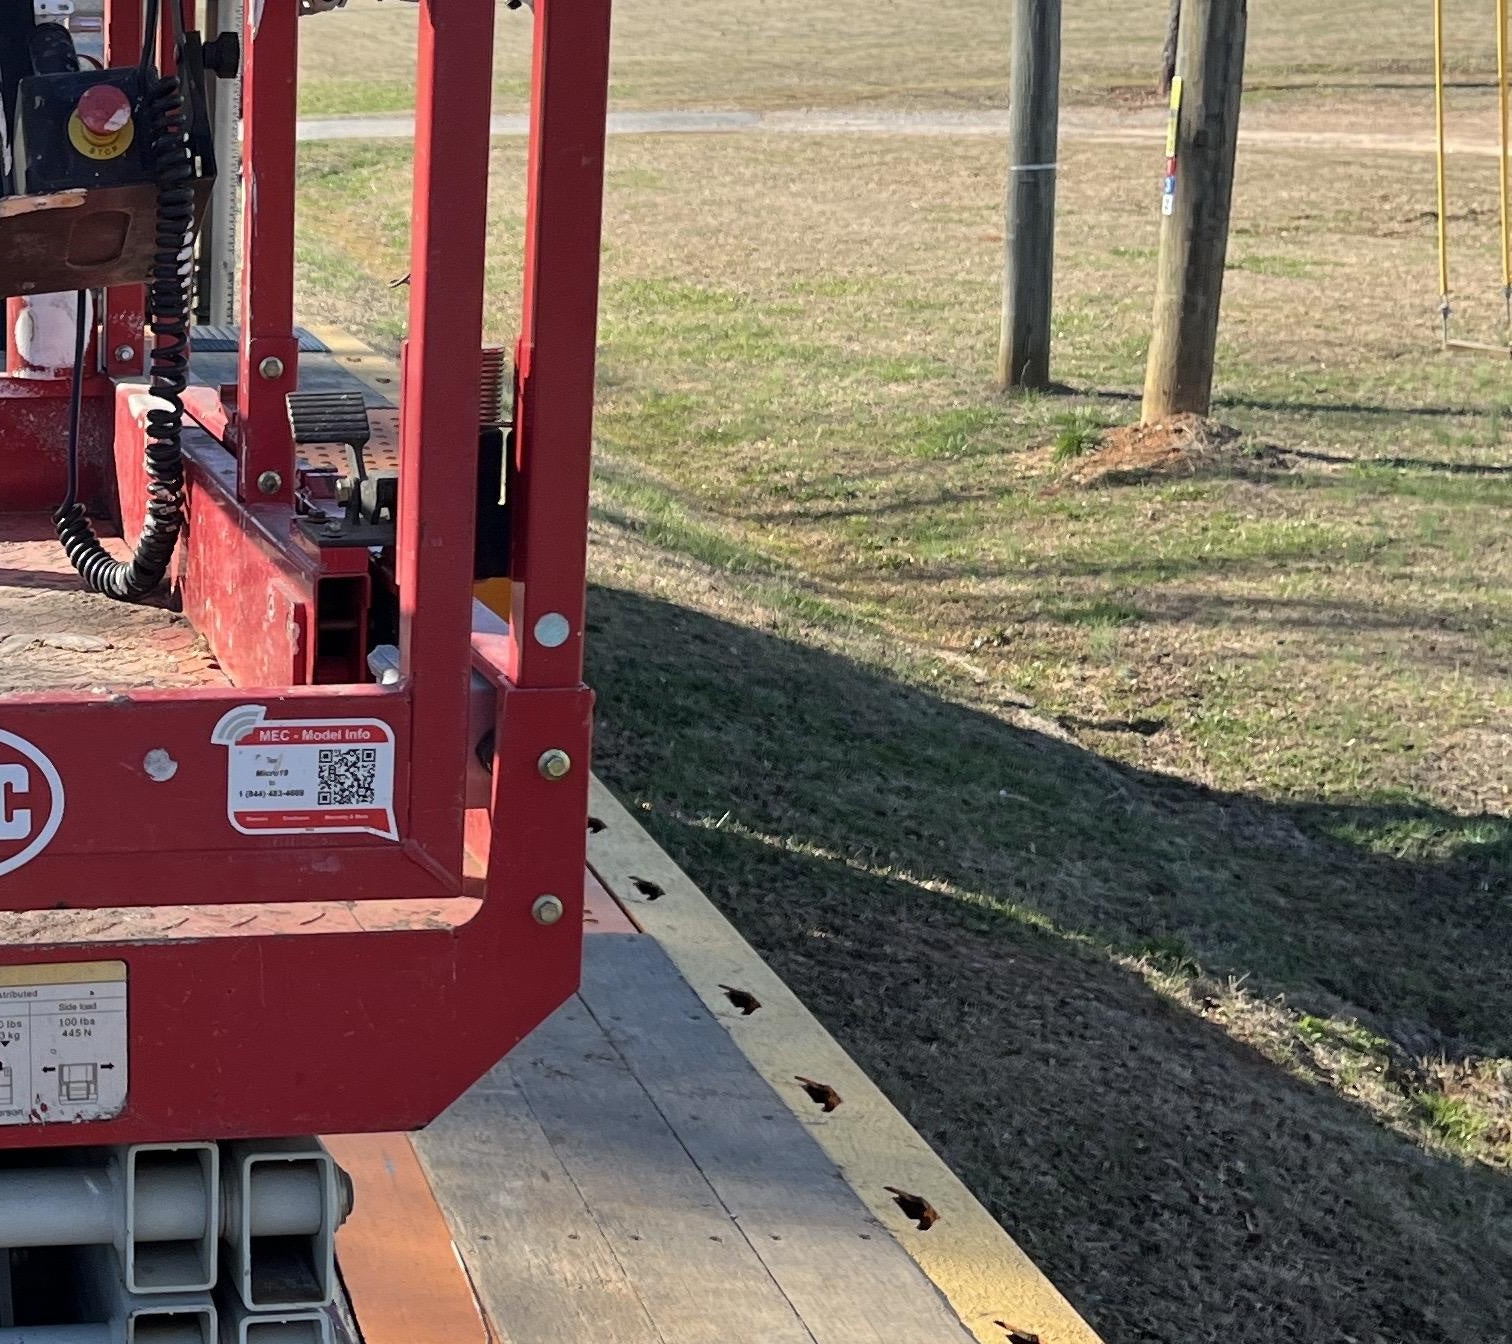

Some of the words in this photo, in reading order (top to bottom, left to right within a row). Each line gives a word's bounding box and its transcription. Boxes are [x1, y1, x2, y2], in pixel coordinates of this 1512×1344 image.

[259, 729, 290, 742] MEC
[302, 729, 342, 741] Model
[345, 728, 371, 740] Info
[58, 1002, 77, 1011] Side
[79, 1002, 97, 1010] load
[6, 1019, 23, 1028] lbs
[59, 1017, 77, 1027] 100
[79, 1017, 95, 1026] lbs
[8, 1031, 21, 1042] kg
[62, 1028, 81, 1037] 445
[83, 1028, 92, 1037] N
